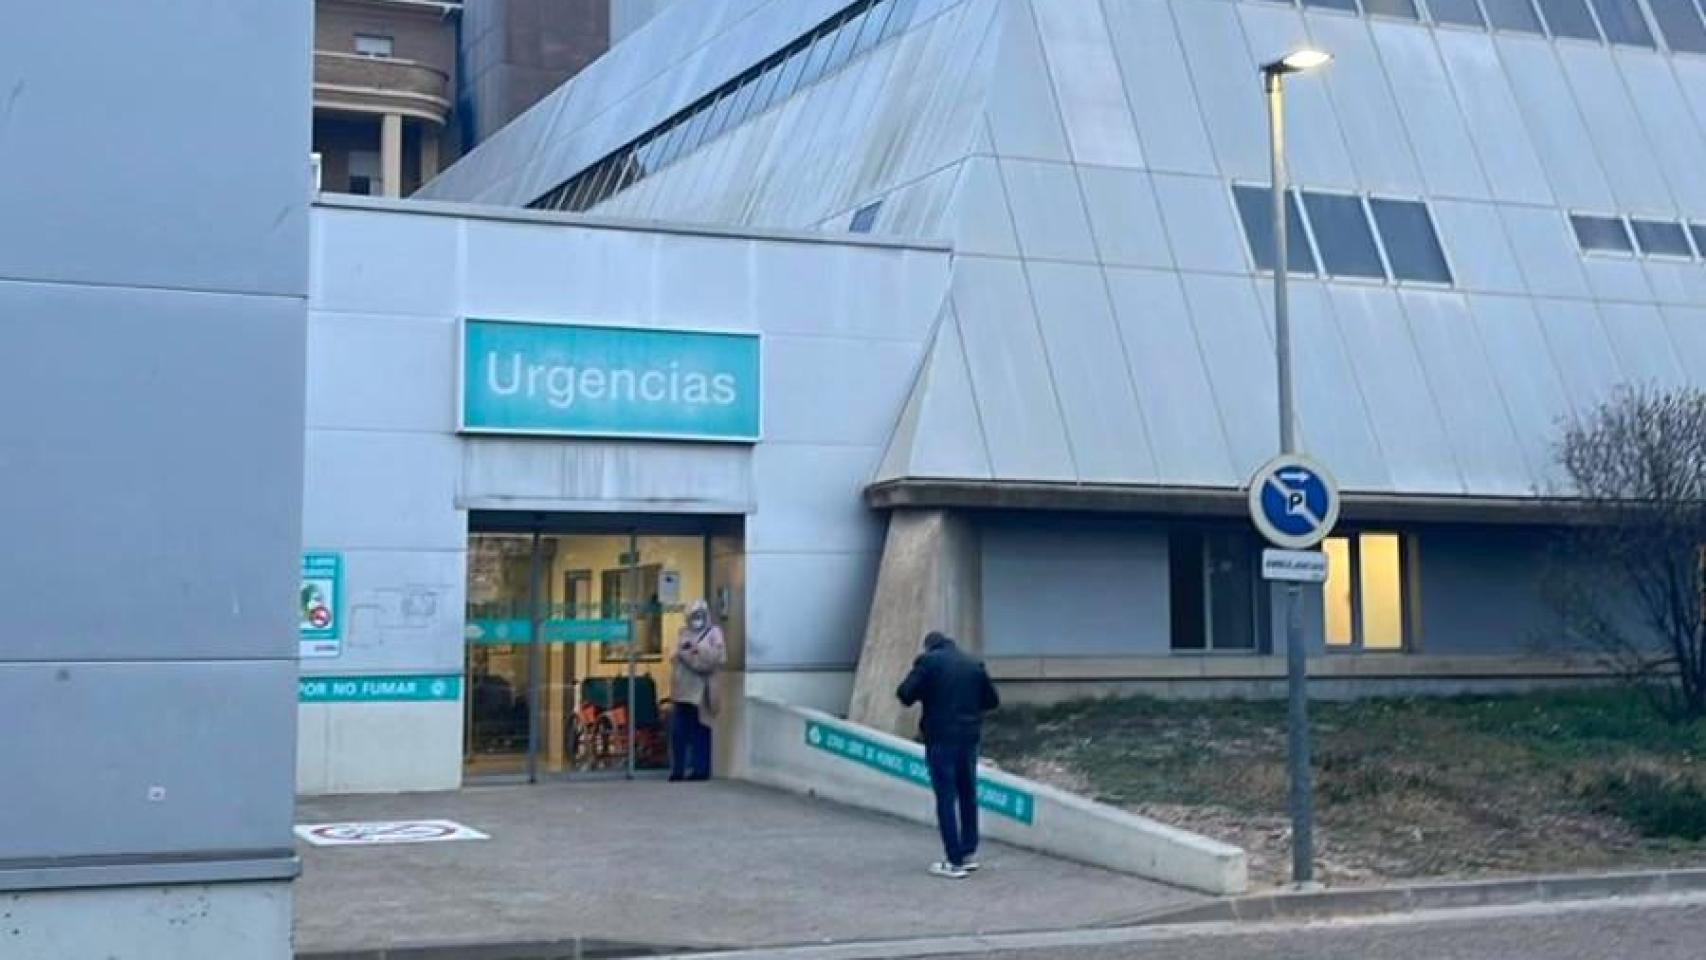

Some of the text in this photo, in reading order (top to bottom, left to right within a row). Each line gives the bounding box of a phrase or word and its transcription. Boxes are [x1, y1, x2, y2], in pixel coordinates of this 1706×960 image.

[487, 351, 736, 408] Urgencias
[1289, 492, 1303, 511] P
[333, 682, 357, 696] NO
[363, 681, 416, 696] FUMAR
